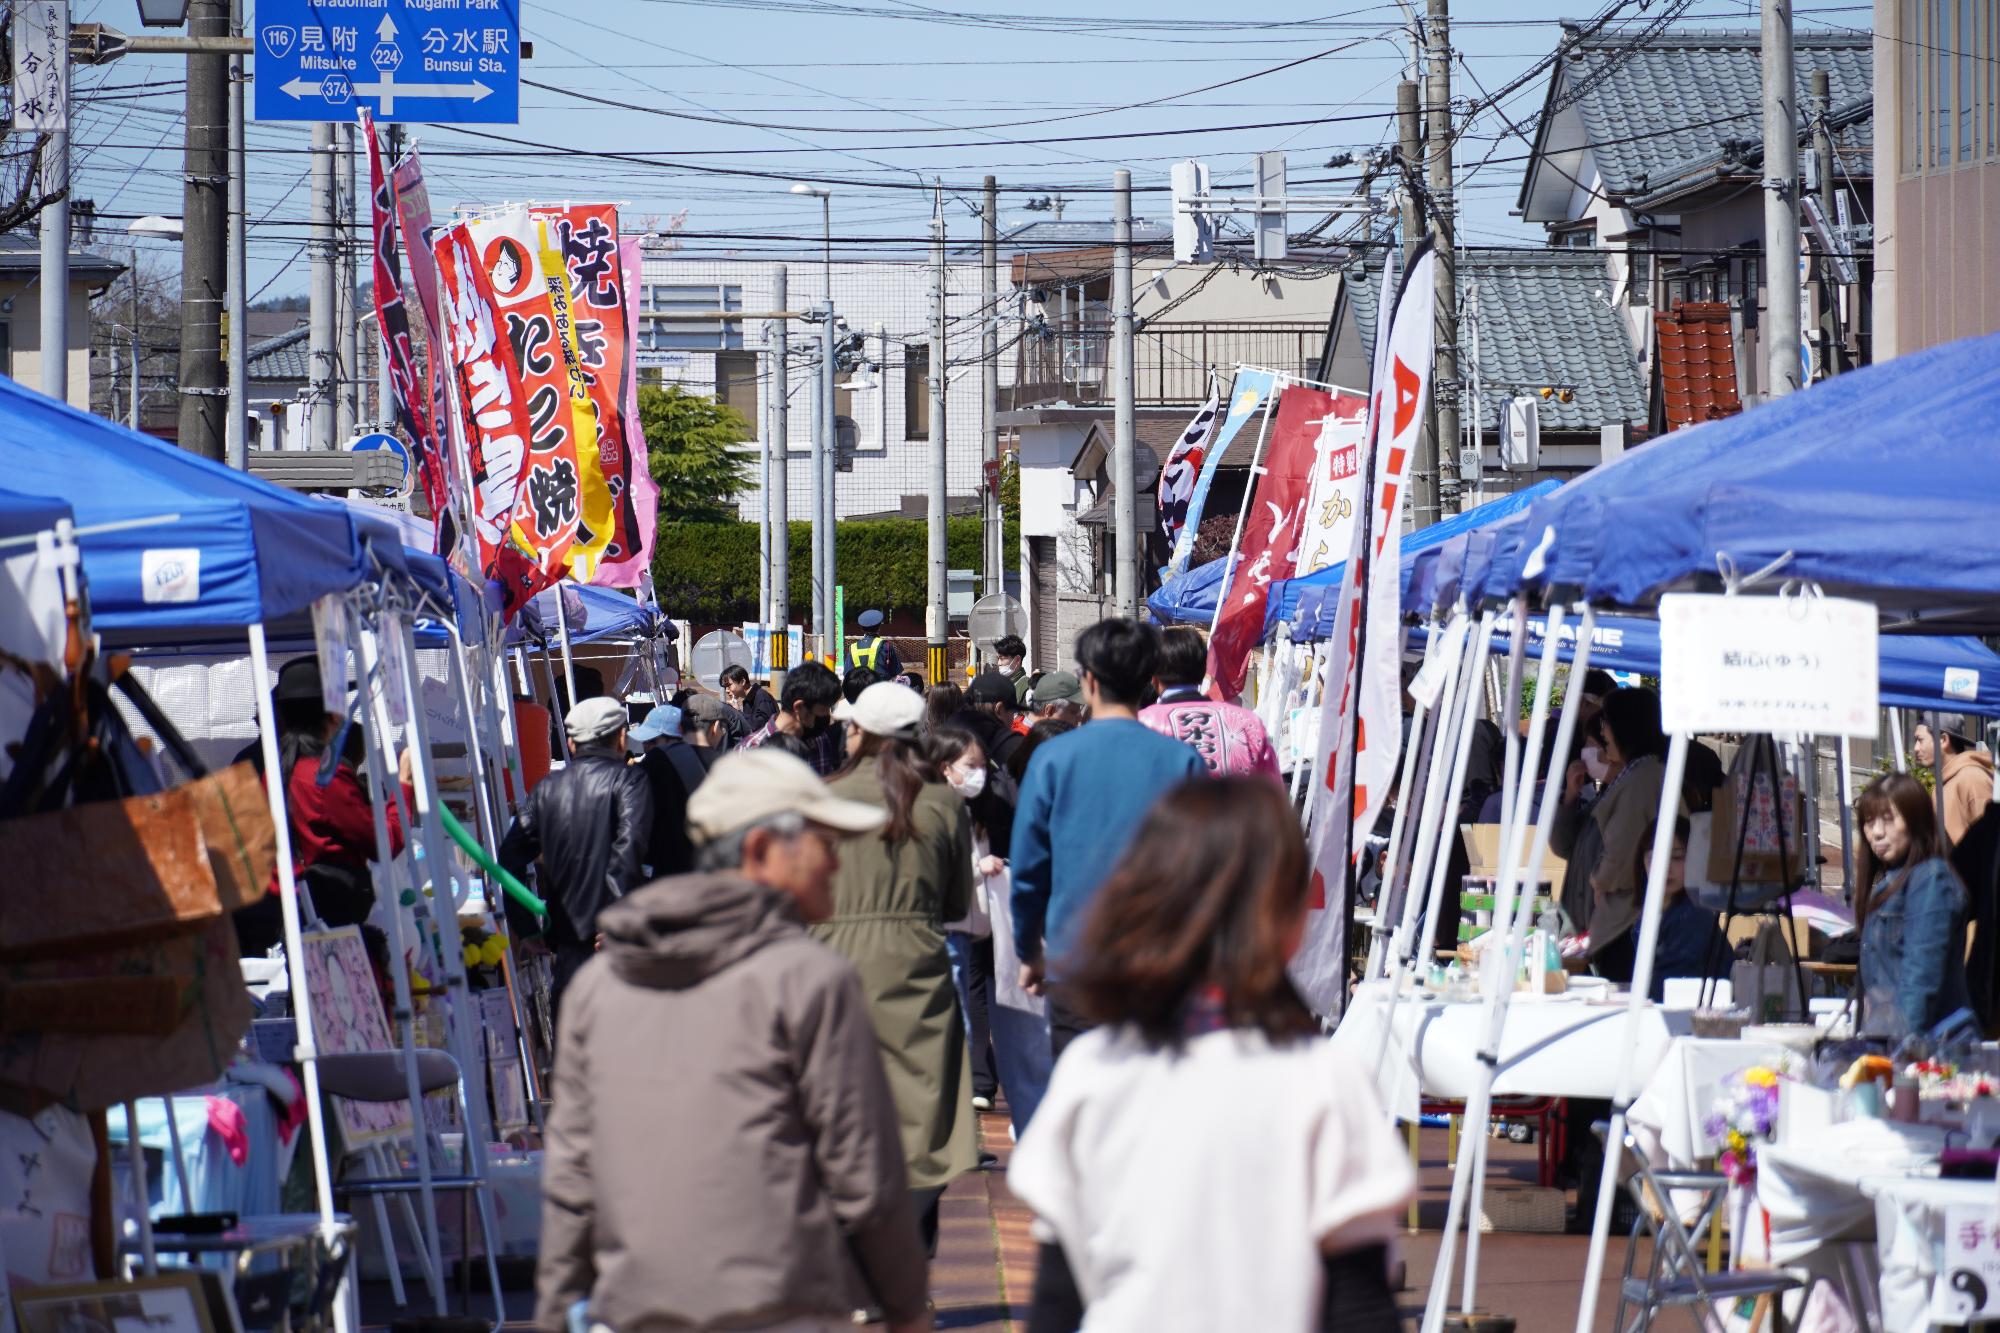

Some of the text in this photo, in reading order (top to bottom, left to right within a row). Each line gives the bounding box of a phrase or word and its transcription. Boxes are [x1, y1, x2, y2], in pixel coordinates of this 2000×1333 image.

[268, 31, 288, 46] 116
[300, 26, 358, 52] 見附
[422, 27, 509, 54] 分水駅
[300, 57, 357, 70] Mitsuke
[375, 50, 398, 65] 224
[424, 58, 506, 73] Bunsui Sta.
[21, 51, 44, 120] 分水
[325, 83, 347, 97] 374
[1332, 448, 1357, 477] 特製
